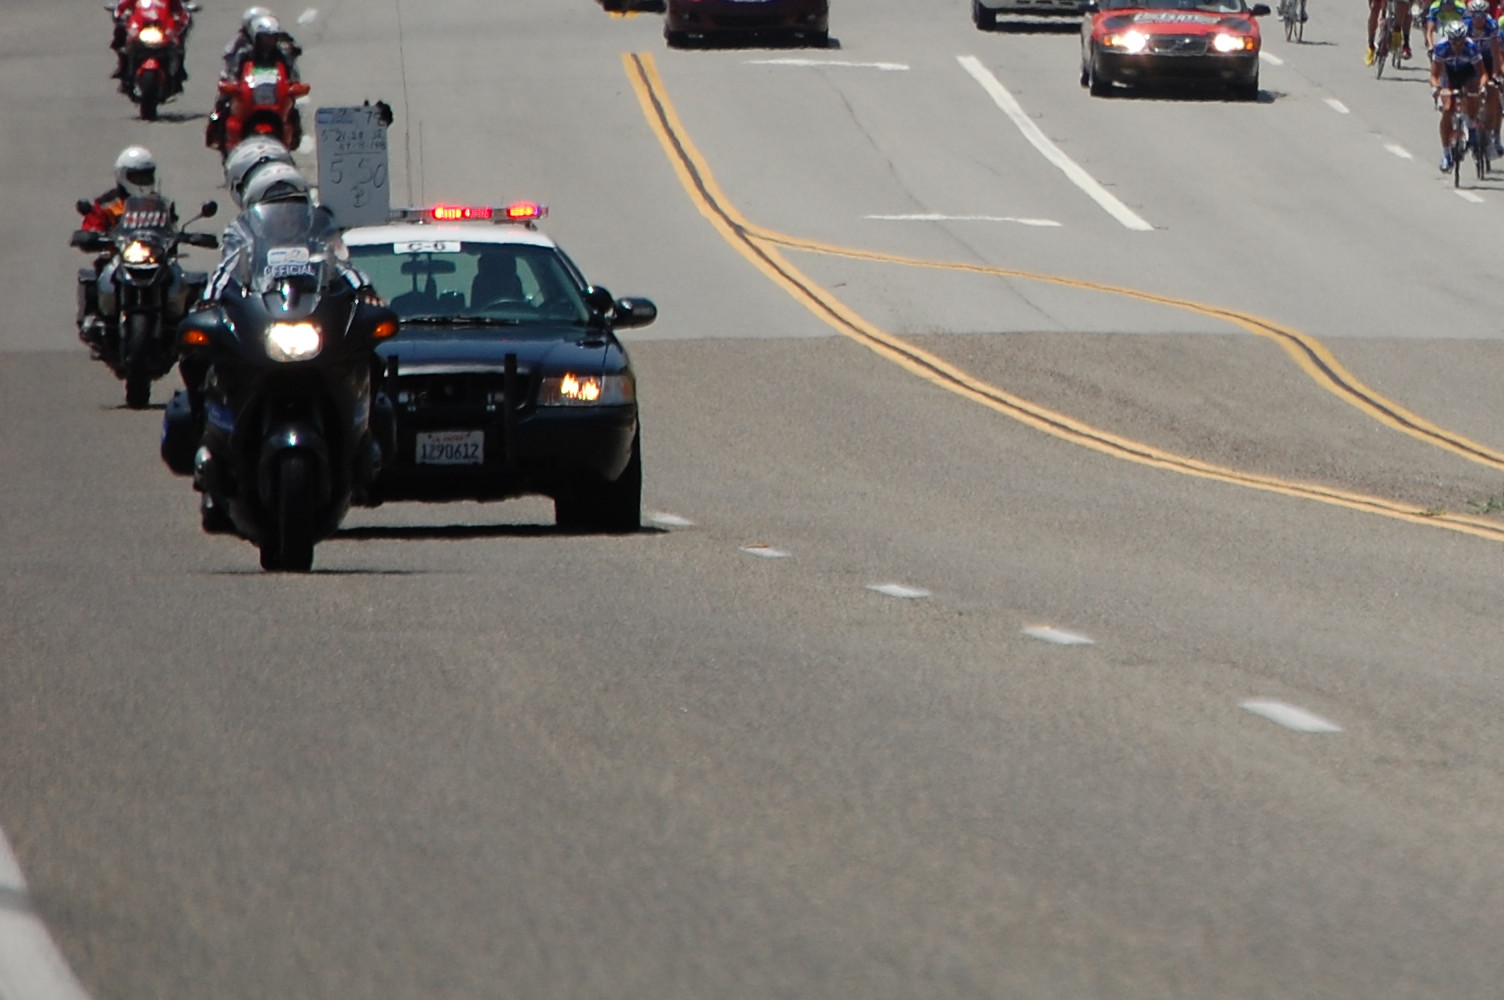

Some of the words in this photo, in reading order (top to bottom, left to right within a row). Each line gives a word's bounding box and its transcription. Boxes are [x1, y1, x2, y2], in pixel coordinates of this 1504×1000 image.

[407, 242, 446, 251] C-6
[263, 264, 316, 277] OFFICIAL
[421, 443, 479, 460] 1290612
